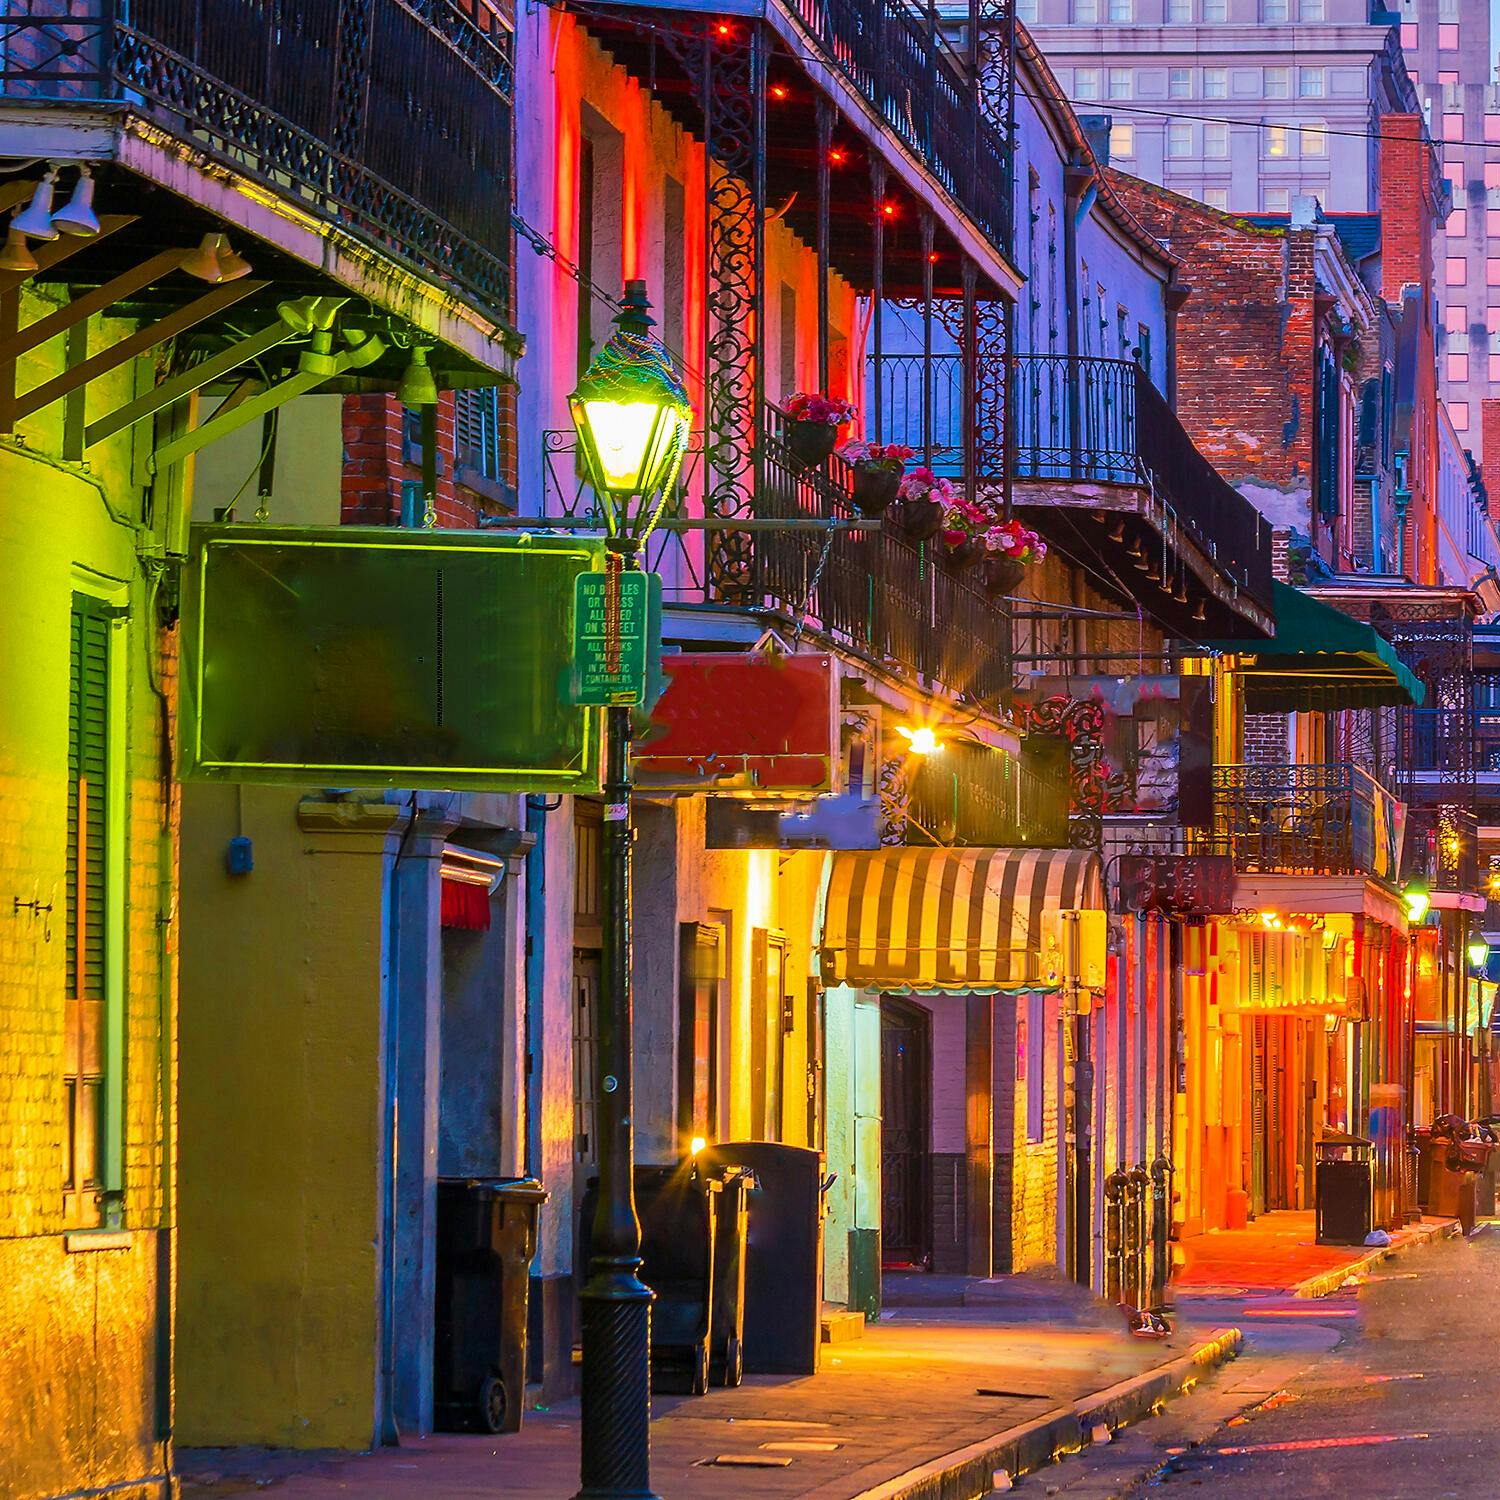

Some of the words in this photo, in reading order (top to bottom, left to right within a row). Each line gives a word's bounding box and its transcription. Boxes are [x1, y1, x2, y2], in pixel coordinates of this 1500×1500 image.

[583, 584, 596, 595] NO
[600, 584, 640, 595] BLES
[588, 597, 600, 608] OR
[590, 610, 632, 621] ALLED
[585, 622, 598, 633] ON
[601, 622, 635, 633] STEET
[587, 642, 601, 652] ALL
[588, 664, 596, 673] IN
[585, 674, 632, 684] CONTAINERS
